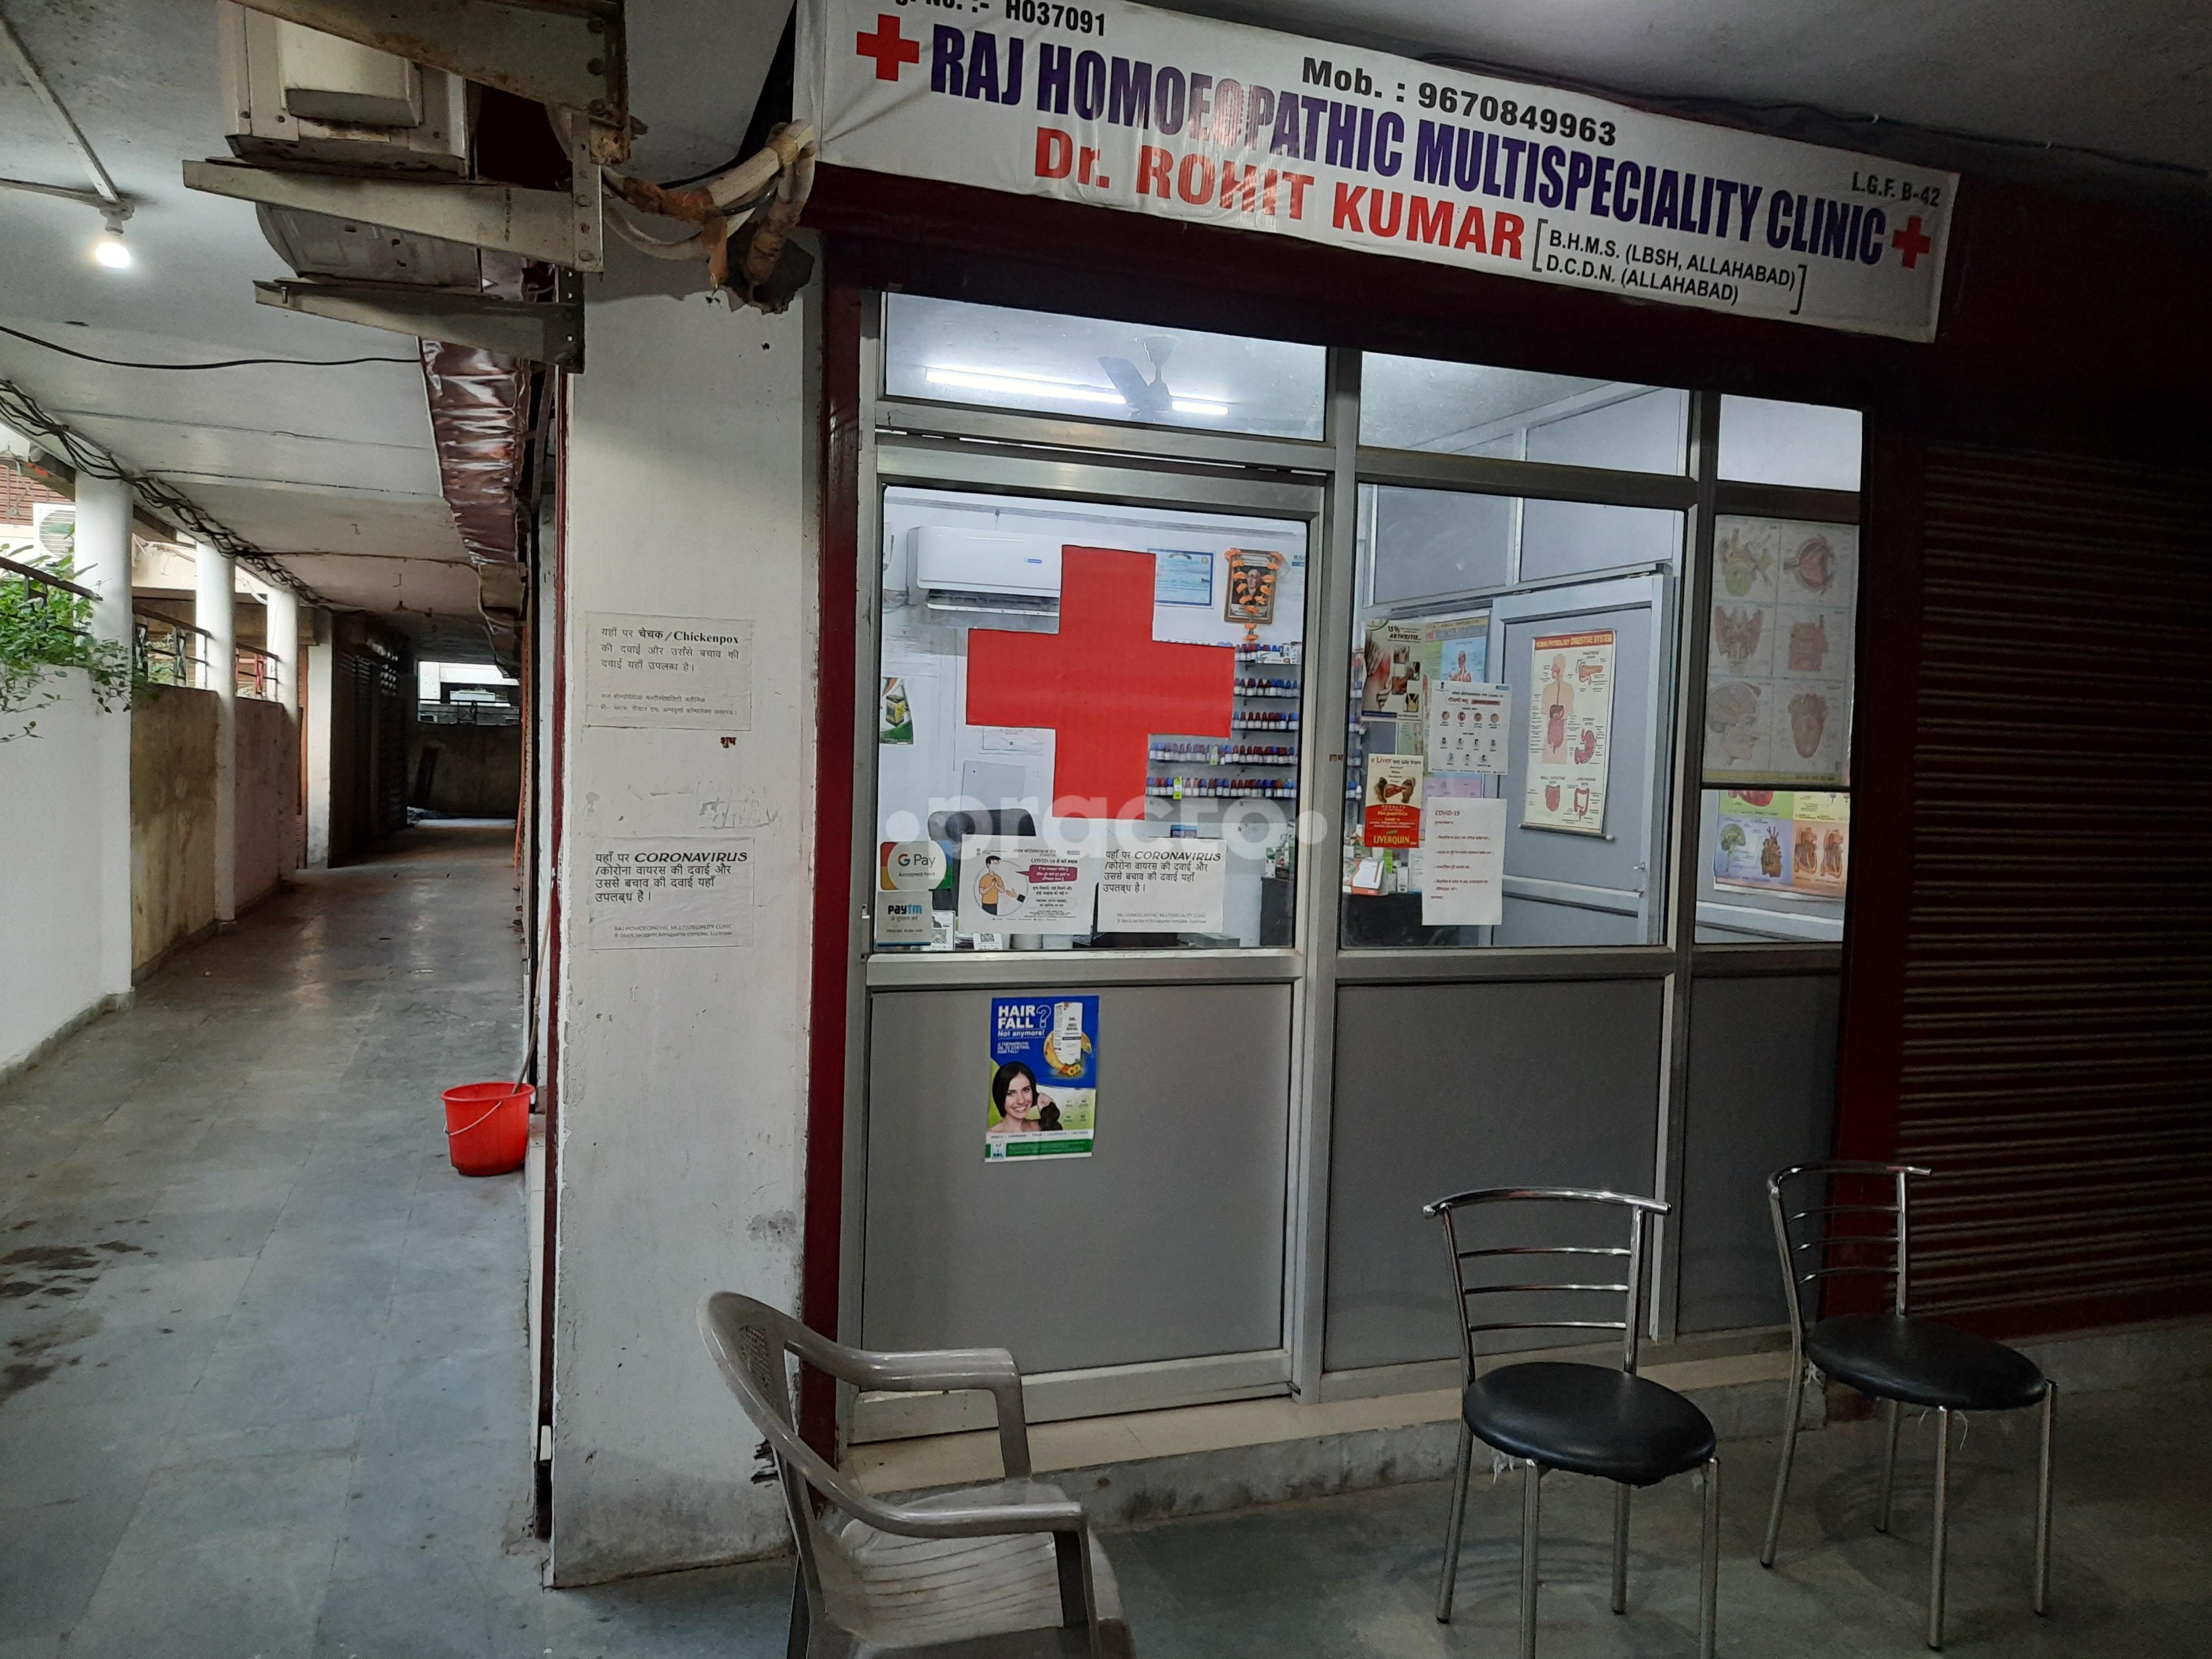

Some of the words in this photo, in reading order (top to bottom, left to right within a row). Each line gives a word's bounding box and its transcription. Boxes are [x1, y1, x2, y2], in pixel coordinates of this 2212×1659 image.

[1005, 0, 1105, 36] H037091
[1302, 57, 1383, 99] Mob.
[1418, 82, 1616, 147] 9670849963
[931, 23, 1025, 106] RAJ
[1037, 42, 1405, 178] HOMOEOPATHIC
[1413, 120, 1763, 243] MULTISPECIALITY
[1766, 189, 1887, 265] CLINIC
[1035, 127, 1110, 189] Dr.
[1135, 144, 1314, 221] ROHIT
[1332, 182, 1526, 260] KUMAR
[1901, 181, 1943, 207] B-42
[1686, 253, 1797, 292] ALLAHABAD)
[1620, 268, 1740, 306] (ALLAHABAD)
[622, 629, 633, 638] पर
[700, 649, 721, 658] बचाव
[720, 737, 737, 748] शुभ
[1374, 836, 1410, 845] LIVERQUIN
[595, 851, 614, 863] यहाँ
[617, 854, 630, 863] पर
[634, 852, 747, 863] CORONAVIRUS
[898, 853, 910, 867] G
[914, 854, 936, 868] Pay
[1105, 849, 1119, 859] यहाँ
[1134, 851, 1221, 861] CORONAVIRUS
[637, 866, 666, 875] वायरस
[670, 864, 682, 875] की
[687, 863, 709, 875] दवाई
[715, 863, 732, 875] और
[1135, 862, 1157, 870] वायरस
[1161, 861, 1170, 870] की
[1174, 861, 1191, 871] दवाई
[1195, 861, 1208, 871] और
[595, 877, 619, 888] उससे
[624, 879, 649, 888] बचाव
[654, 877, 665, 888] की
[671, 875, 693, 888] दवाई
[698, 875, 715, 888] यहाँ
[1104, 871, 1122, 880] उससे
[1147, 871, 1156, 881] की
[1160, 871, 1178, 882] दवाई
[1181, 872, 1196, 882] यहाँ
[888, 904, 922, 915] paytm
[998, 1005, 1035, 1017] HAIR
[998, 1017, 1034, 1030] FALL
